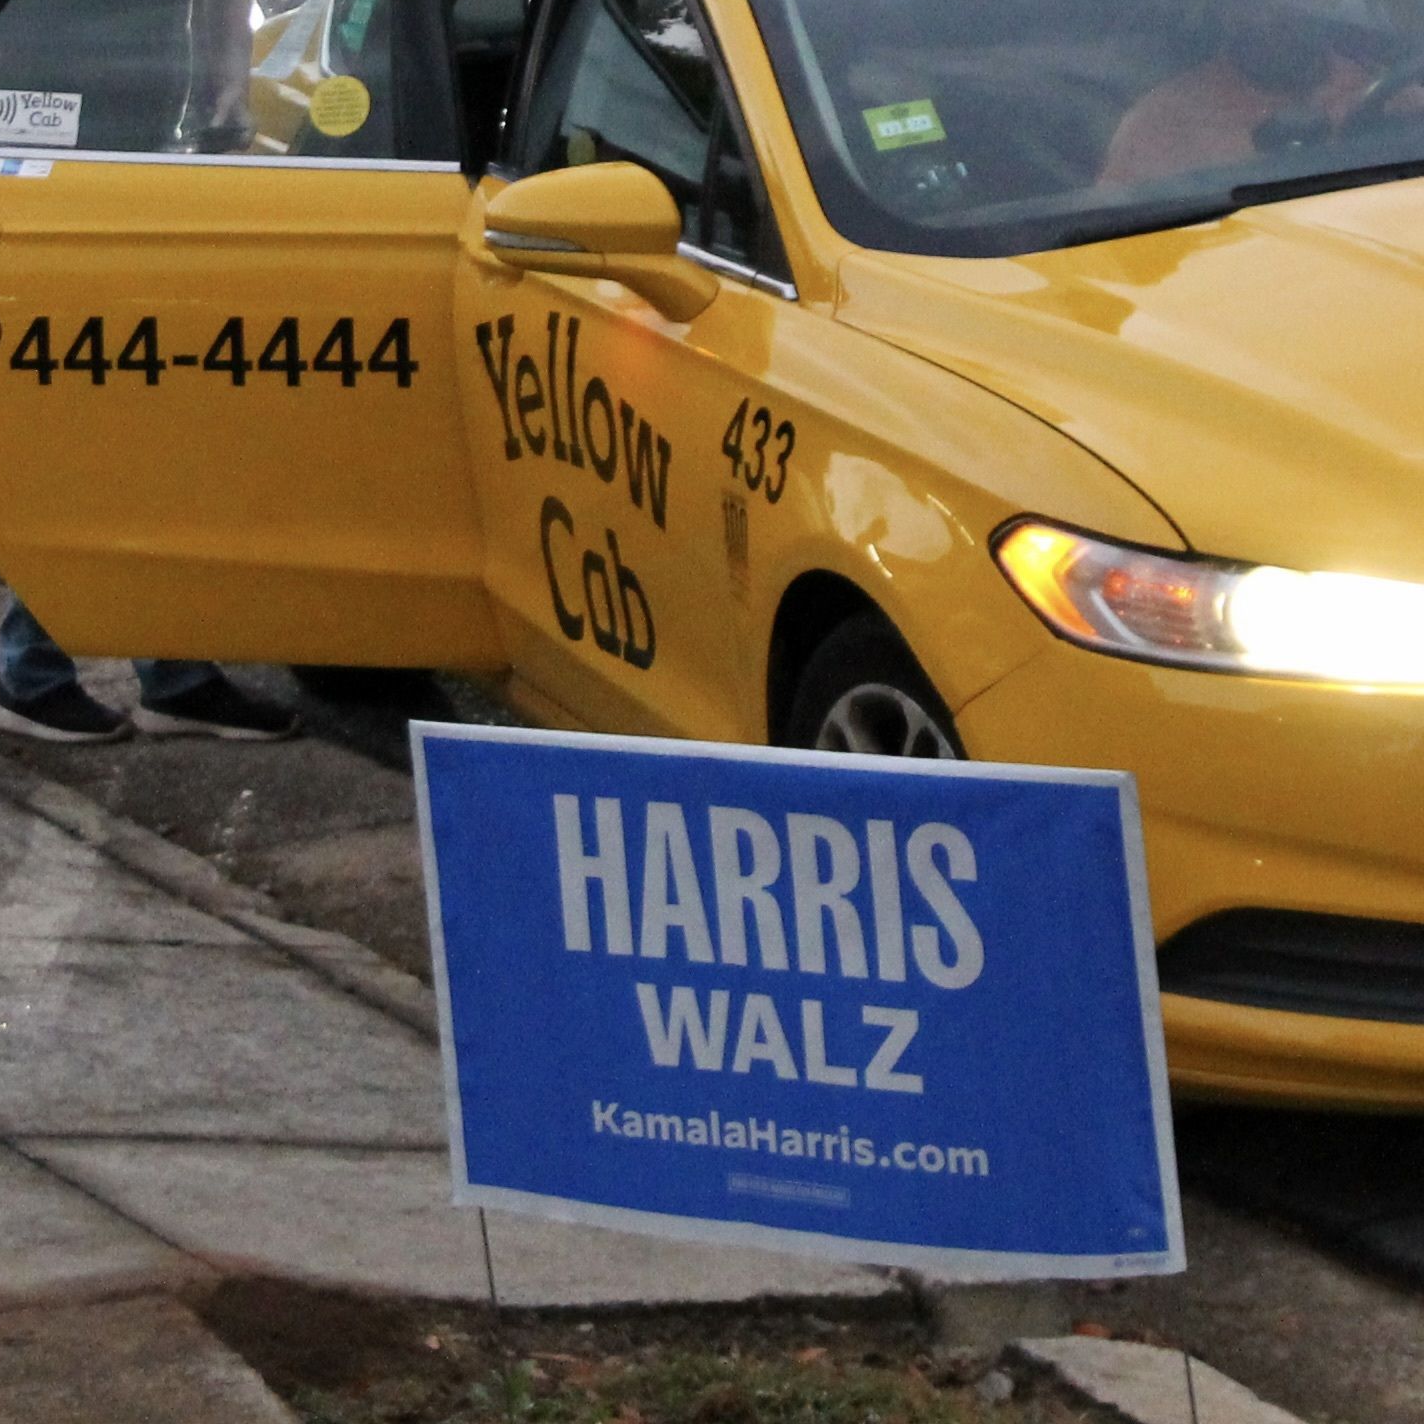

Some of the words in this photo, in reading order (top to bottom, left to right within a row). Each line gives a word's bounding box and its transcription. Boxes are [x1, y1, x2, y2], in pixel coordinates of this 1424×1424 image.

[21, 91, 78, 112] Yellow
[29, 111, 63, 127] Cab
[10, 315, 419, 387] 444-4444
[475, 311, 673, 533] Yellow
[722, 396, 796, 504] 433
[540, 495, 657, 671] Cab
[551, 793, 986, 991] HARRIS
[635, 982, 927, 1095] WALZ
[592, 1099, 990, 1180] KamalaHarris.com
